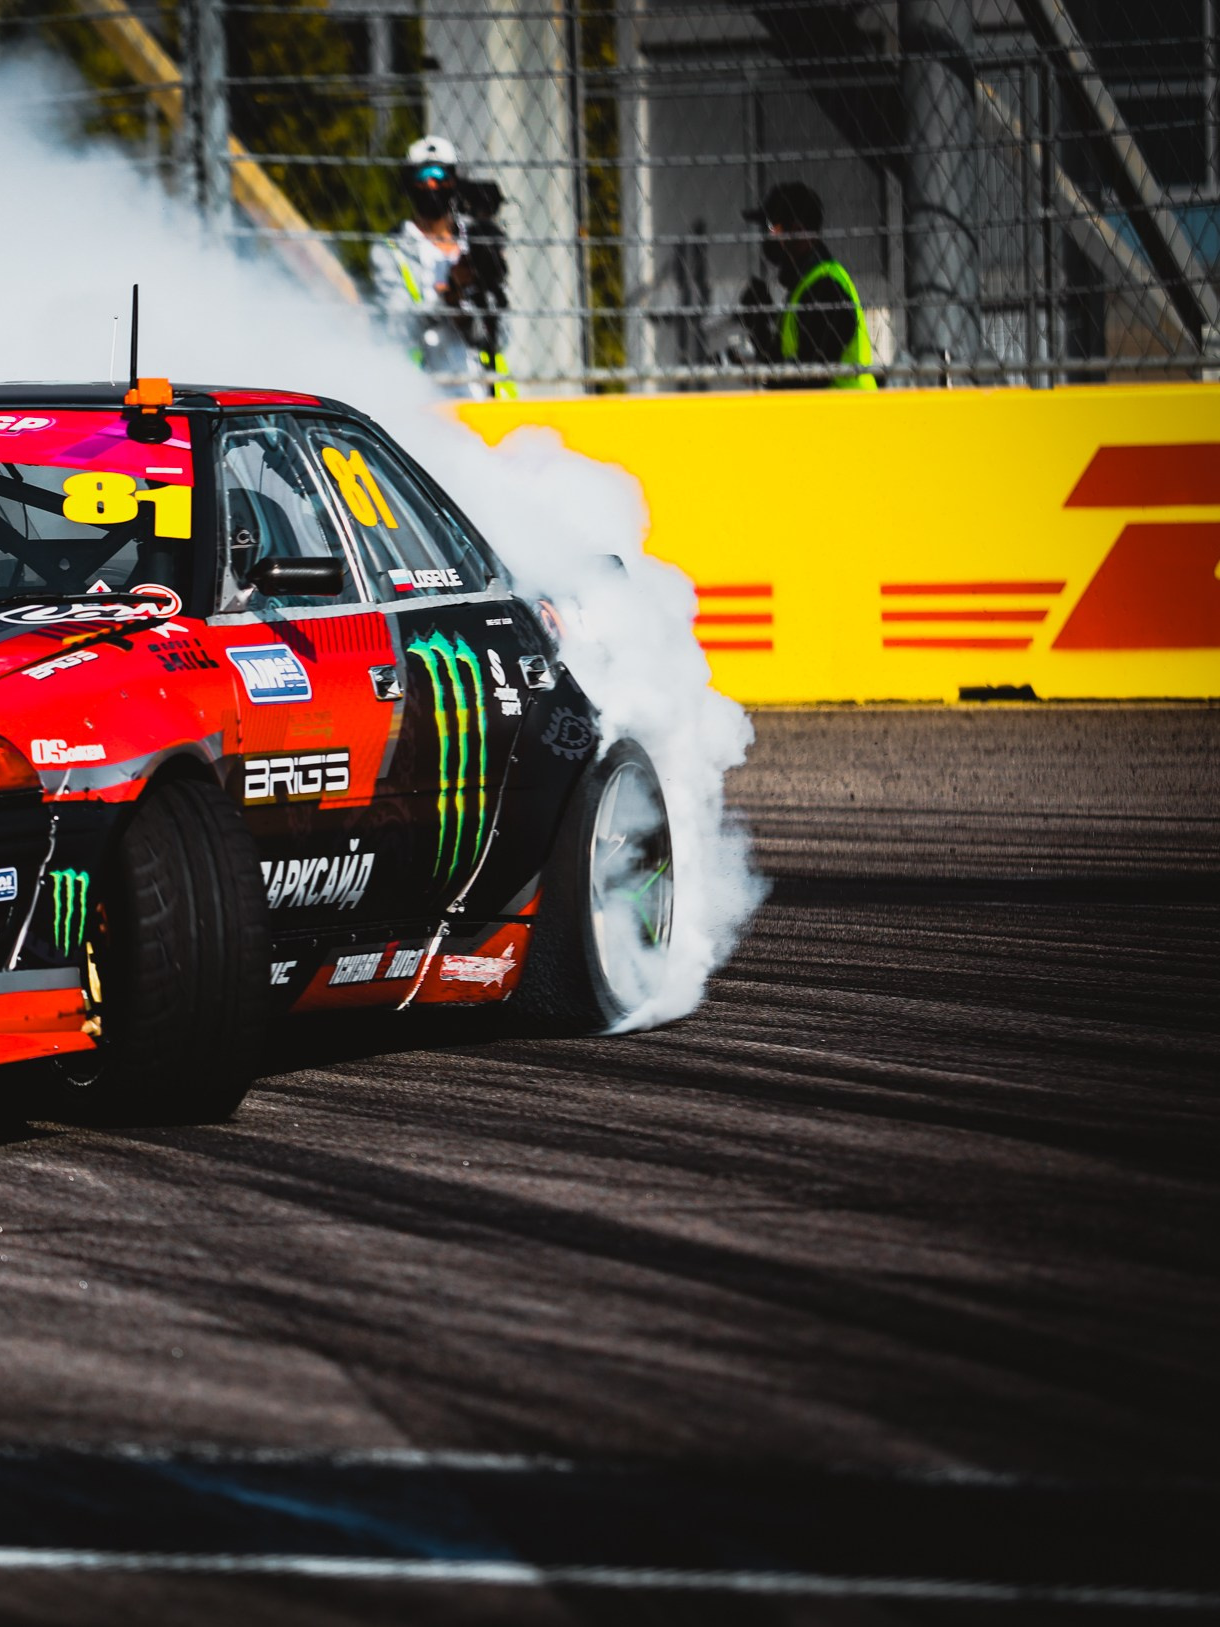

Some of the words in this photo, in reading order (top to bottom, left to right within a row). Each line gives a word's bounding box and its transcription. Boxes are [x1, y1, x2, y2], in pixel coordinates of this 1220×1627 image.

[63, 472, 192, 539] 81
[322, 446, 399, 529] 81
[245, 752, 349, 799] BRIGS
